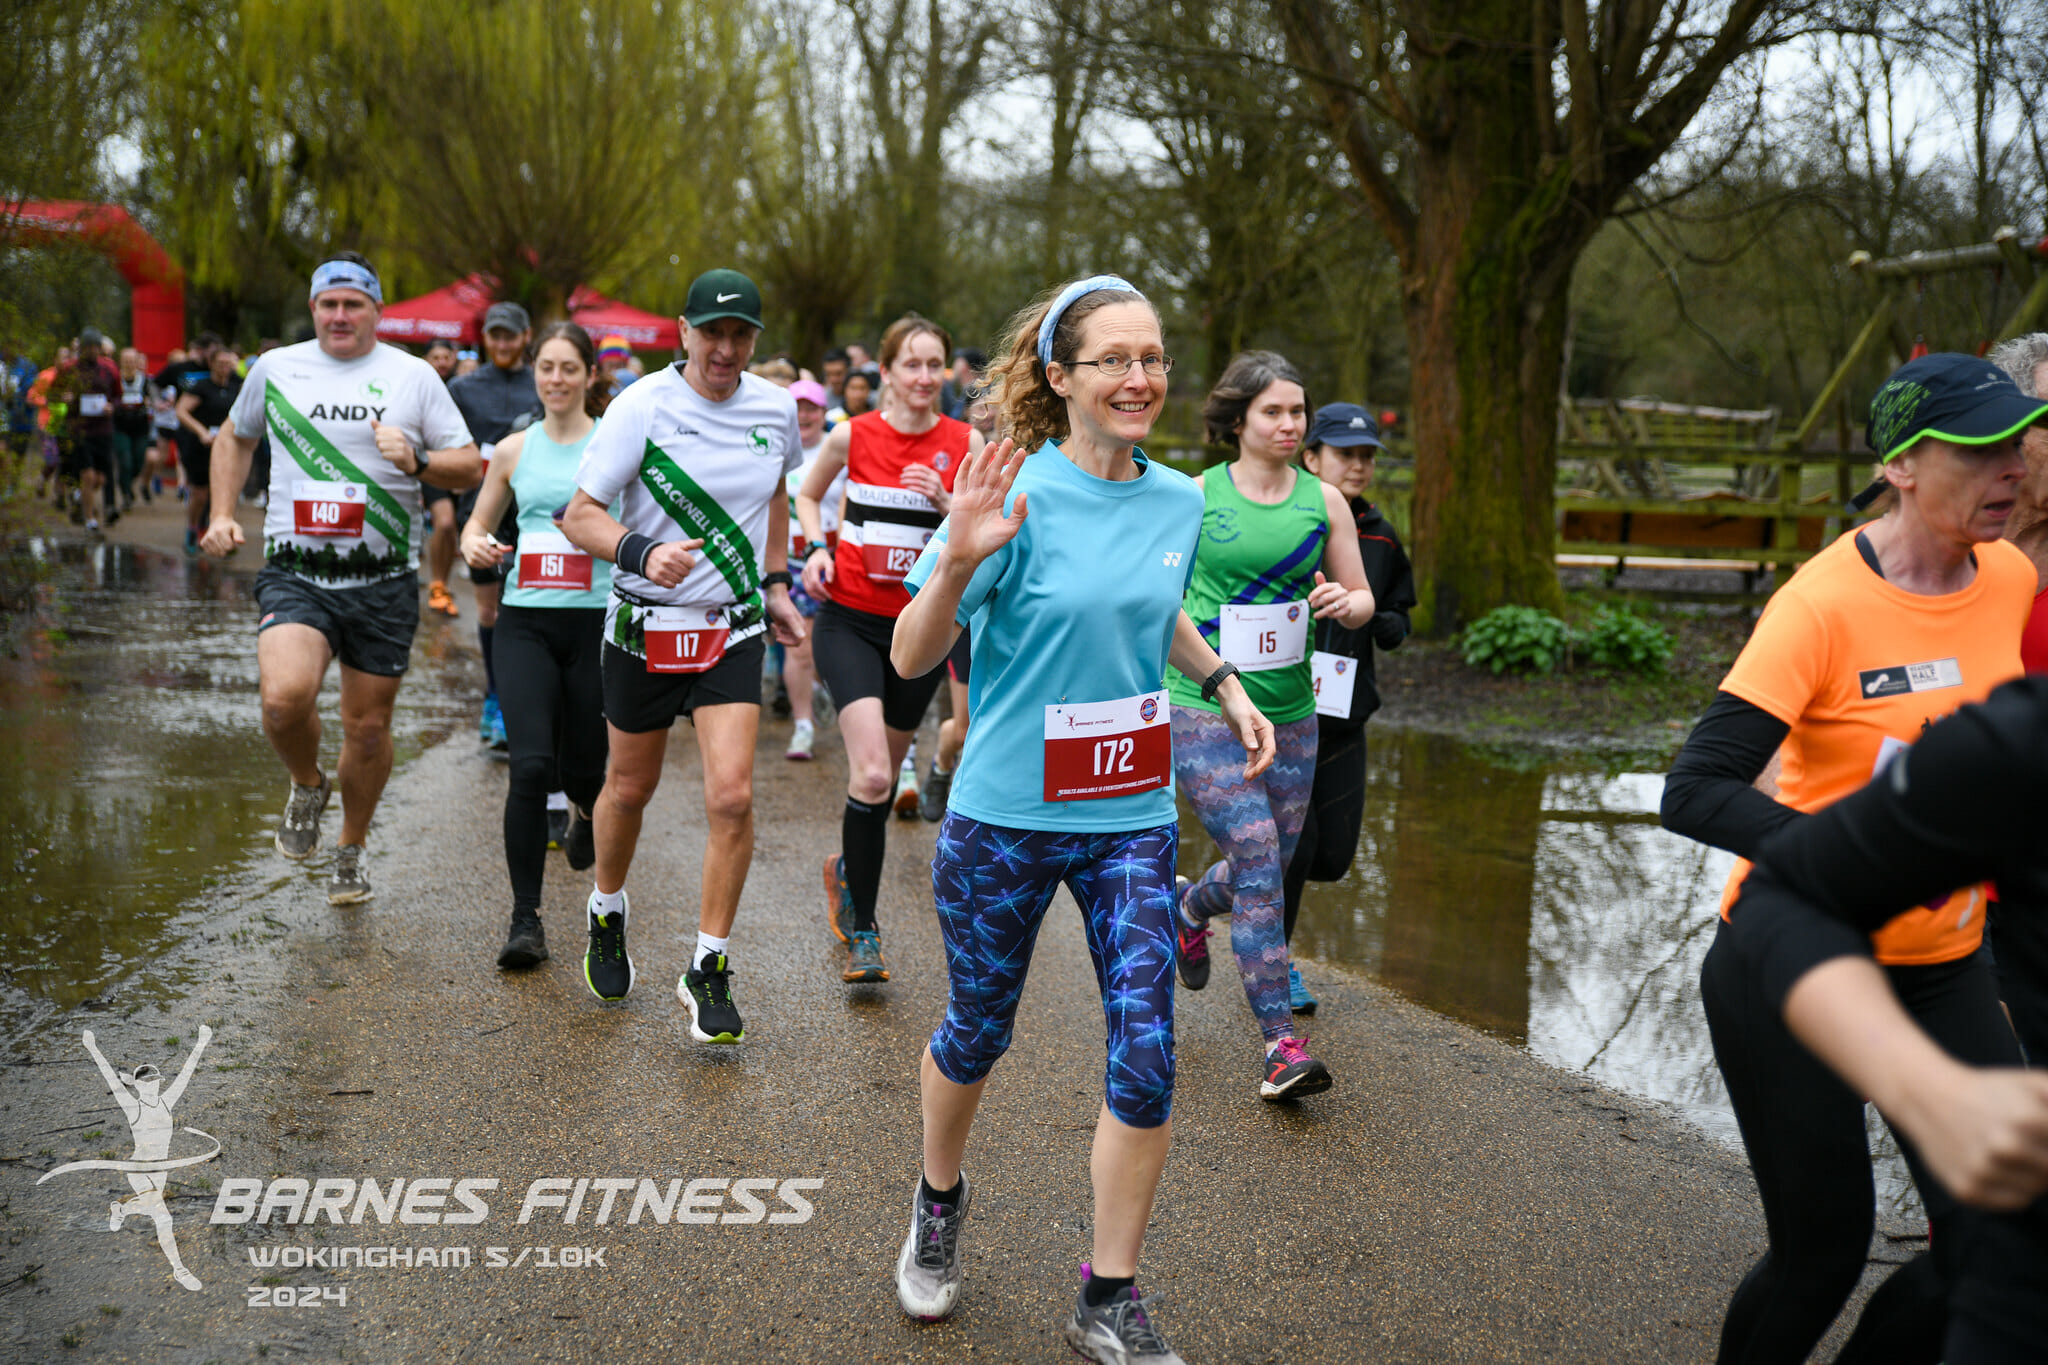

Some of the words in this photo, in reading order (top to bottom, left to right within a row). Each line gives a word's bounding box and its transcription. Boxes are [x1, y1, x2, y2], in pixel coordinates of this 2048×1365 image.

[309, 403, 387, 422] ANDY
[646, 465, 711, 532] BRACKNELL
[311, 502, 340, 524] 140
[541, 554, 564, 577] 151
[887, 548, 916, 572] 123
[676, 633, 699, 658] 117
[1259, 631, 1276, 654] 15
[1912, 669, 1937, 682] HALF
[1093, 737, 1135, 776] 172
